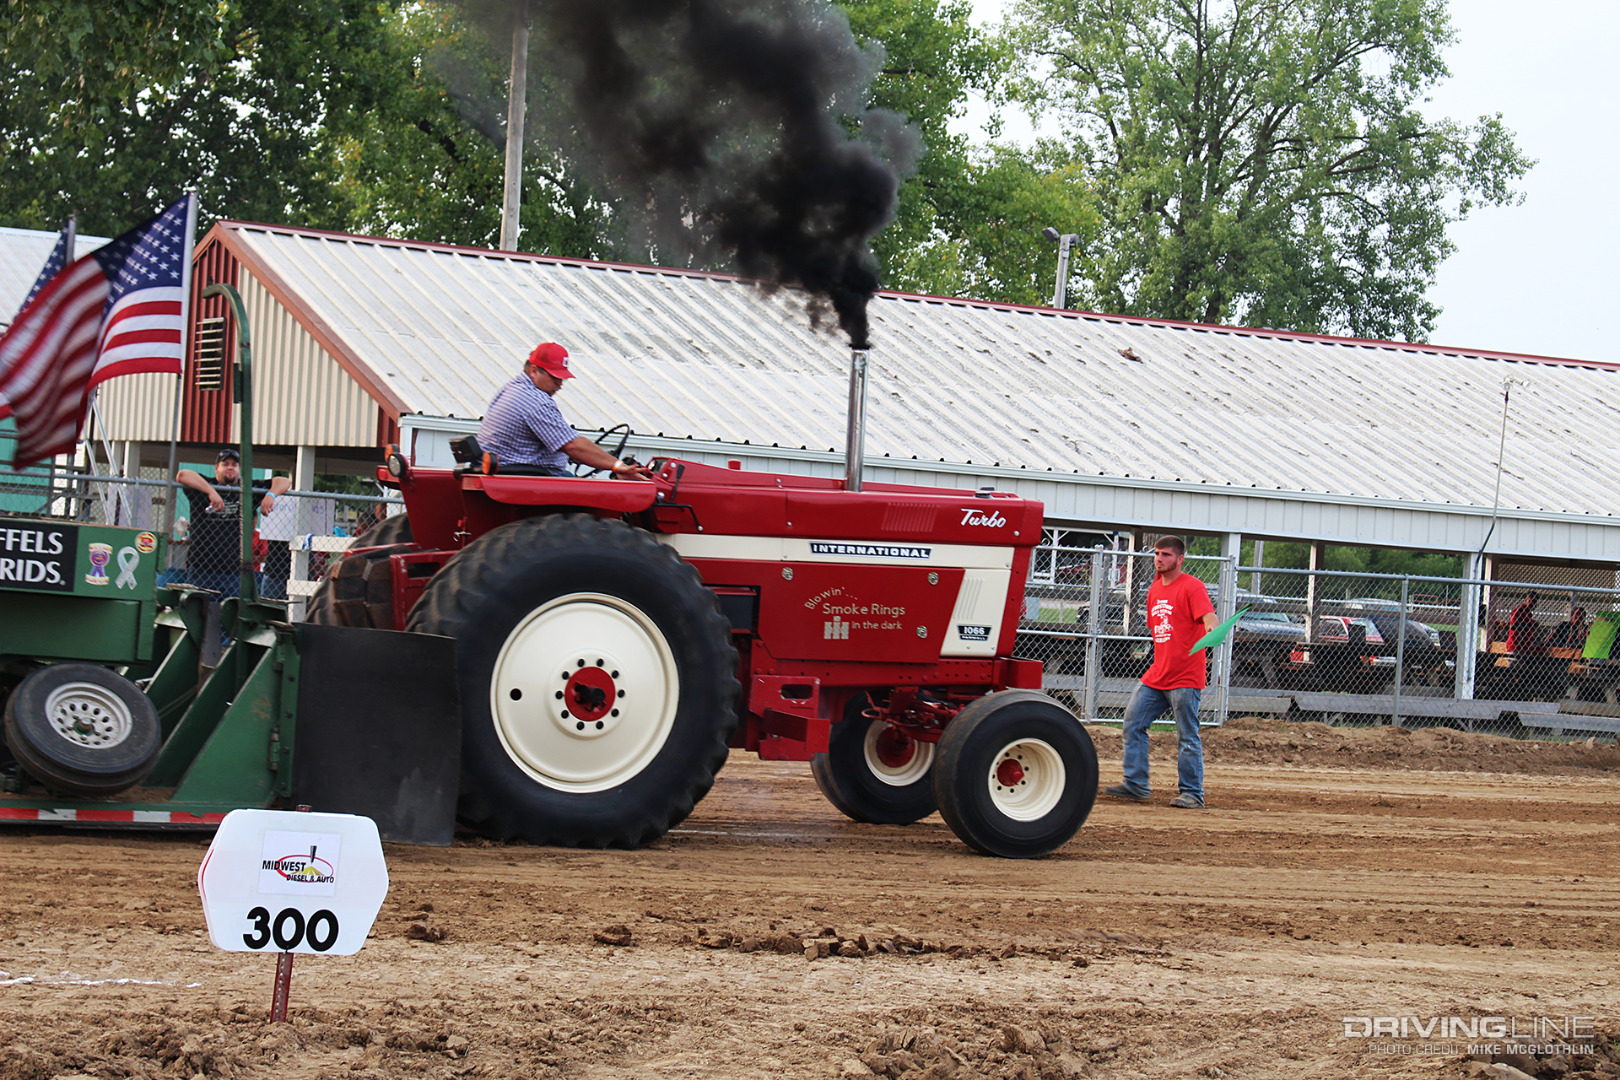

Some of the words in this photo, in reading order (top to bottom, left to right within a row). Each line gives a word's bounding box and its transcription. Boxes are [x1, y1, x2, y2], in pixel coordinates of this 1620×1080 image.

[960, 508, 1007, 528] Turbo
[813, 544, 929, 558] INTERNATIONAL
[823, 603, 868, 615] Smoke
[871, 603, 906, 618] Rings
[862, 621, 879, 630] the
[880, 621, 902, 630] dark
[963, 626, 985, 635] 1066
[262, 860, 306, 872] MIDWEST
[286, 874, 308, 883] DIESEL
[316, 876, 334, 884] AUTO
[243, 906, 339, 952] 300
